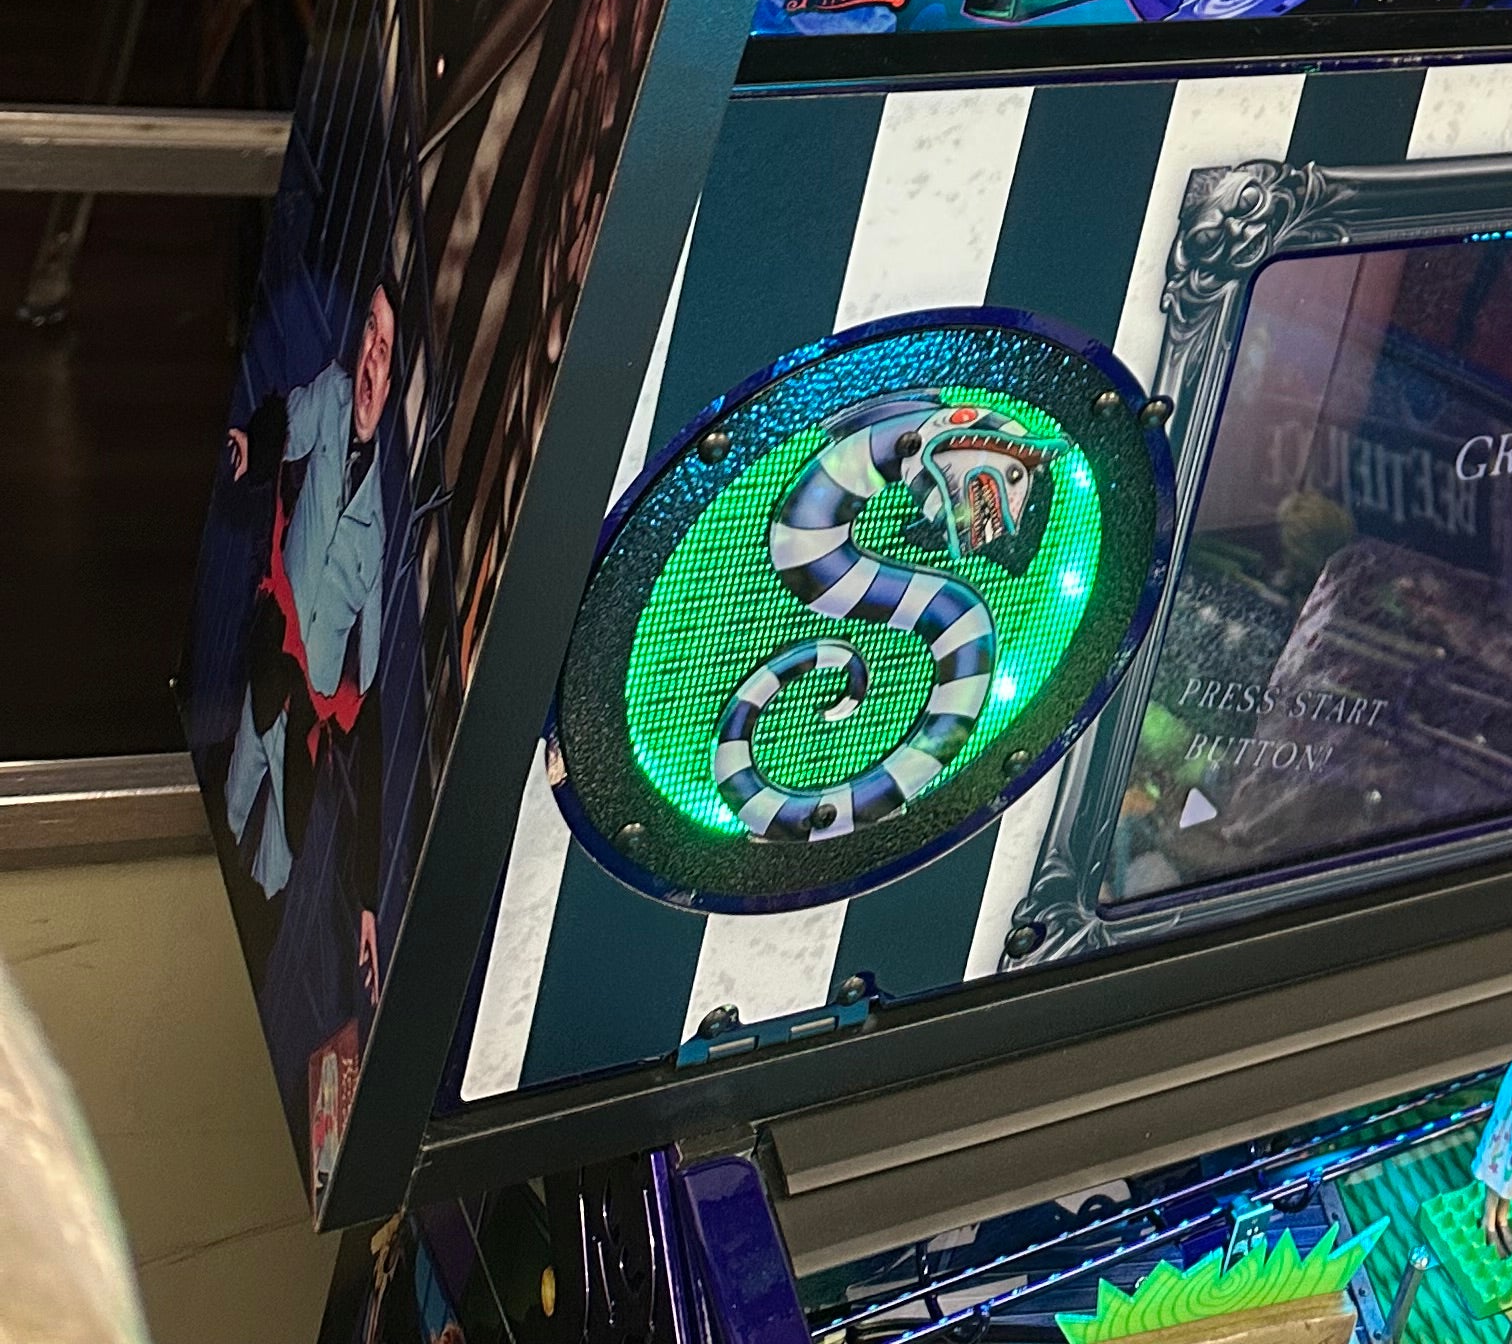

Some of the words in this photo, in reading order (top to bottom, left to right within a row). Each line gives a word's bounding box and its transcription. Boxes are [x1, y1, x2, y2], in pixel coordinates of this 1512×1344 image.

[1178, 678, 1281, 714] PRESS
[1288, 690, 1388, 727] START
[1184, 733, 1334, 773] BUTTON!
